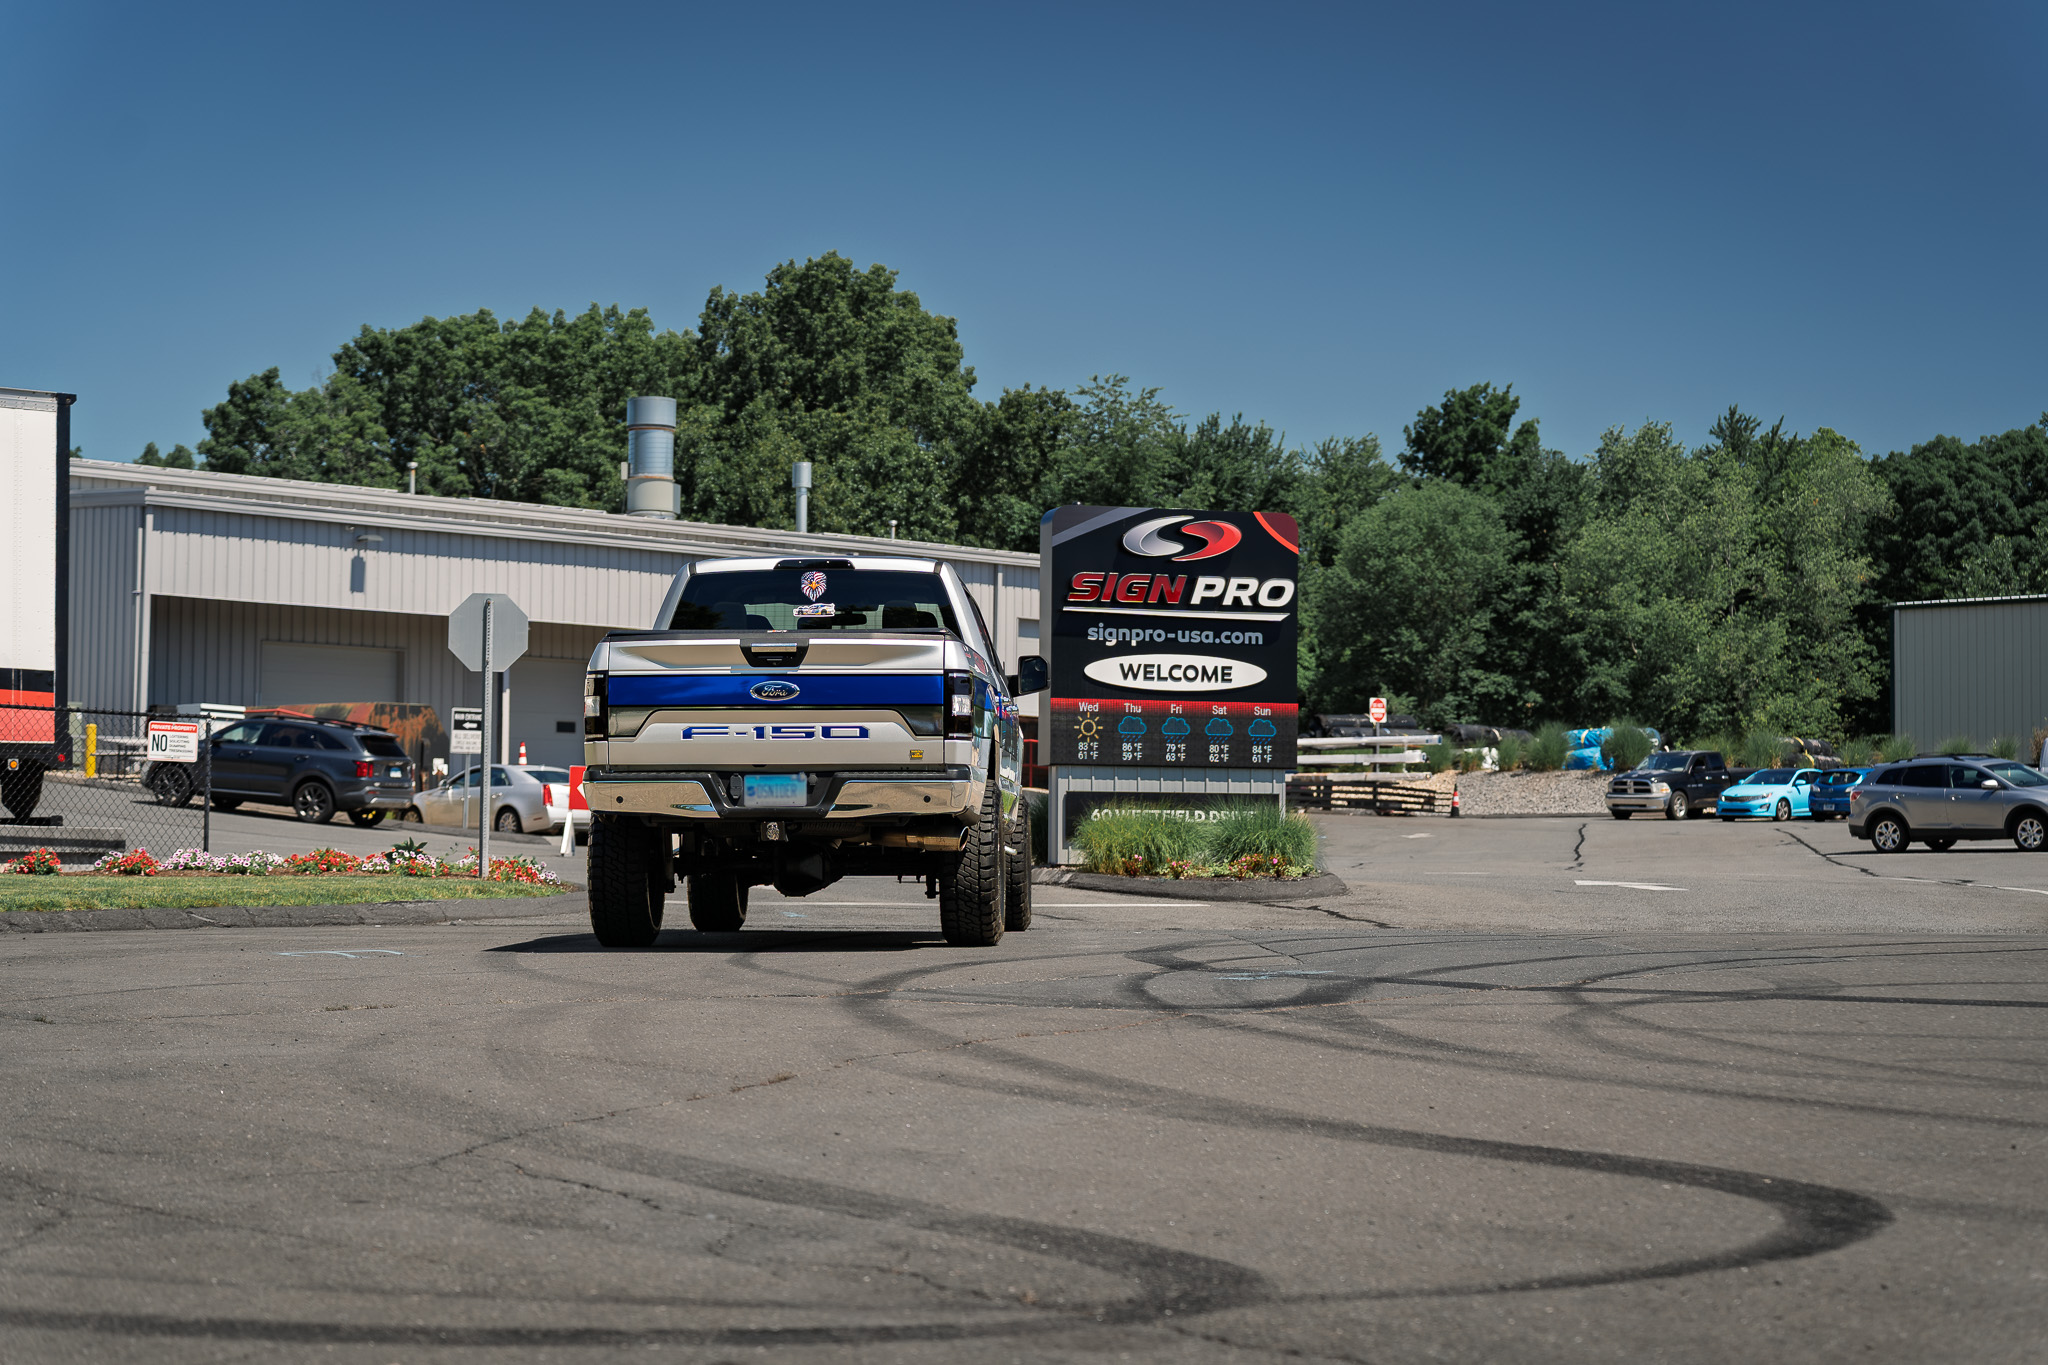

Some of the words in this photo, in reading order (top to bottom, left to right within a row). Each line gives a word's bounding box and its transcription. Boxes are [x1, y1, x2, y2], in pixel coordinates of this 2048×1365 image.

[1067, 571, 1188, 604] SIGN
[1190, 576, 1295, 607] PRO
[1087, 622, 1263, 646] signpro-usa.com
[1119, 663, 1233, 683] WELCOME
[761, 685, 788, 697] Ford
[1078, 702, 1098, 712] Wed
[1124, 703, 1142, 713] Thu
[1170, 704, 1182, 714] Fri
[1212, 705, 1227, 715] Sat
[1254, 706, 1272, 716] Sun
[681, 726, 870, 740] F-150
[152, 734, 168, 752] NO
[1078, 742, 1088, 750] 83
[1122, 743, 1132, 752] 86
[1166, 744, 1176, 752] 79
[1209, 745, 1219, 753] 80
[1252, 746, 1262, 754] 84
[1078, 752, 1088, 760] 61
[1122, 752, 1132, 760] 59
[1166, 753, 1176, 762] 63
[1209, 754, 1220, 762] 62
[1252, 755, 1262, 763] 61
[1210, 810, 1258, 823] DRI
